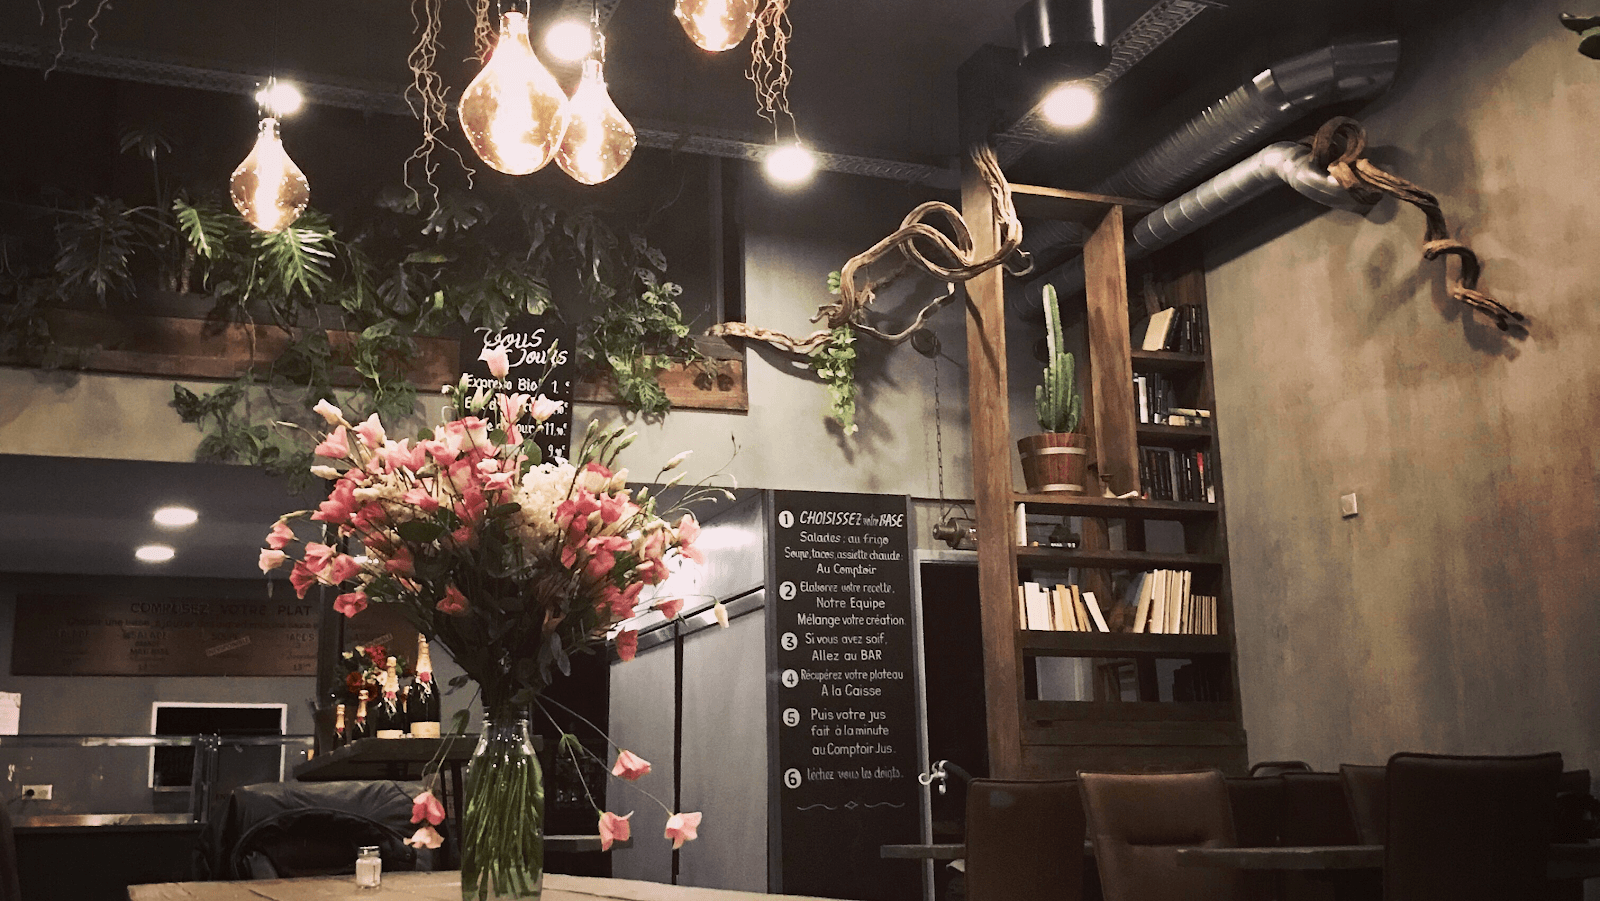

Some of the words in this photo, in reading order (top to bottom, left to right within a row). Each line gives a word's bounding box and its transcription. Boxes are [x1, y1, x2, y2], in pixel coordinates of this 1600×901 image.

[518, 378, 538, 391] Bio
[517, 423, 535, 434] our
[799, 511, 862, 525] CHOISISSEZ
[879, 513, 904, 527] BASE
[848, 535, 860, 544] au
[863, 534, 889, 548] frigo
[837, 550, 868, 560] assiette
[817, 563, 830, 574] Au
[834, 563, 876, 577] Comptoir
[800, 581, 838, 593] Elaborez
[842, 582, 860, 593] votre
[130, 602, 211, 615] COMPOSEZ
[220, 603, 267, 616] VOTRE
[277, 604, 313, 617] PLAT
[816, 597, 846, 608] Notre
[850, 598, 886, 610] Equipe
[798, 613, 840, 628] Mélange
[842, 615, 864, 625] votre
[805, 632, 815, 644] Si
[817, 635, 838, 644] vous
[842, 635, 862, 644] avez
[812, 650, 839, 661] Allez
[844, 653, 857, 661] au
[861, 650, 882, 660] BAR
[801, 669, 842, 683] Récupérez
[845, 670, 868, 680] votre
[870, 669, 904, 681] plateau
[821, 685, 829, 696] A
[832, 684, 842, 696] la
[845, 684, 881, 696] Caisse
[811, 708, 834, 720] Puis
[836, 709, 865, 720] votre
[868, 710, 886, 723] jus
[811, 725, 830, 736] fait
[844, 725, 854, 736] la
[855, 724, 889, 736] minute
[812, 745, 826, 755] au
[827, 743, 874, 757] Comptoir
[838, 771, 858, 779] vous
[861, 767, 872, 779] les
